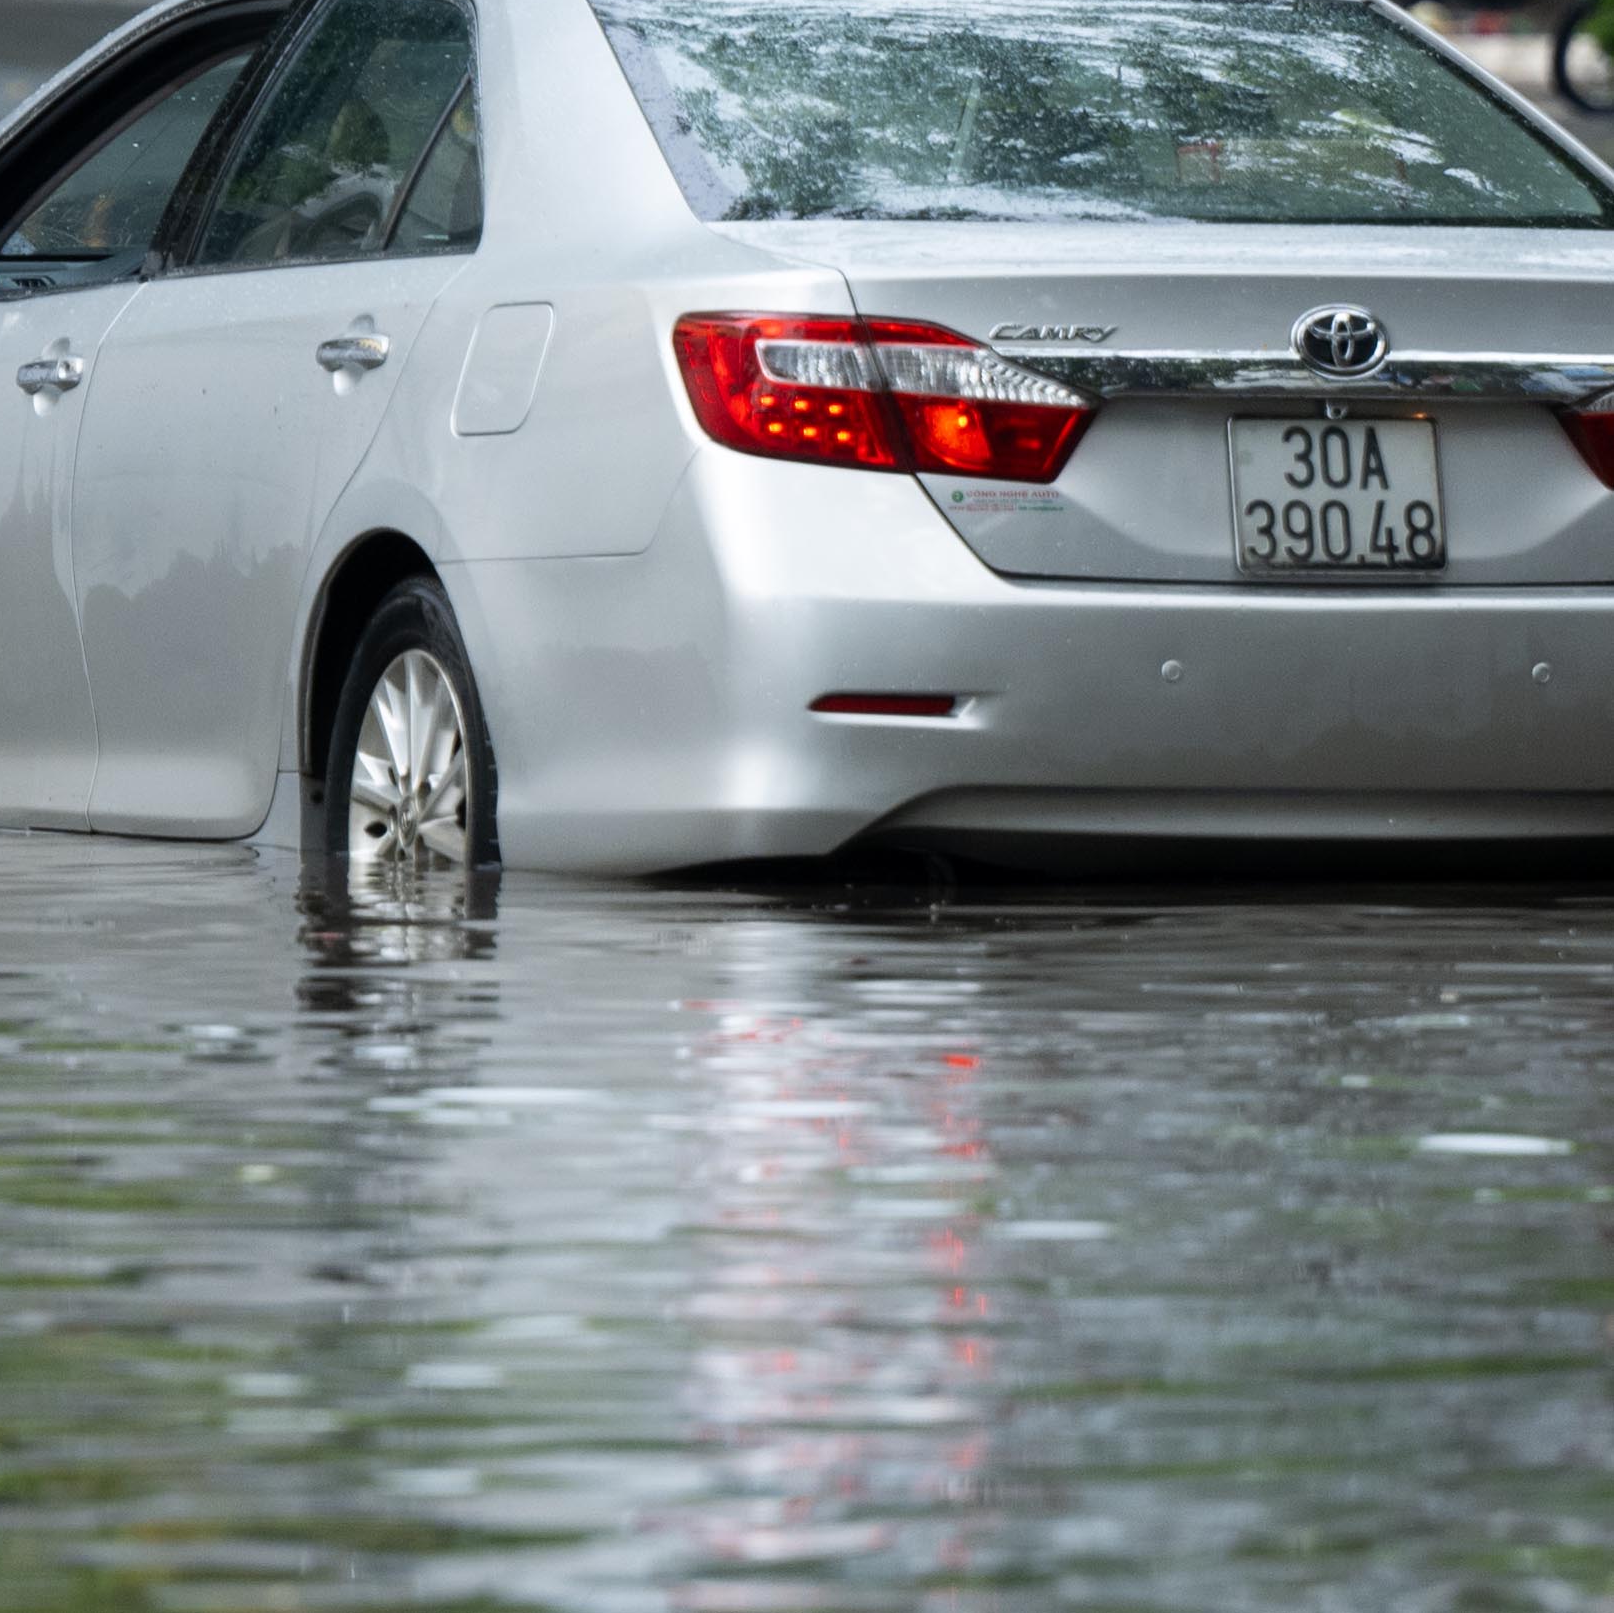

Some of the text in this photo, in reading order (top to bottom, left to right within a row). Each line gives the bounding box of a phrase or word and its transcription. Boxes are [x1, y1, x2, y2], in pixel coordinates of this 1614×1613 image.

[988, 323, 1118, 344] CAMRY
[1281, 425, 1389, 491] 30A
[1244, 499, 1436, 567] 390.48
